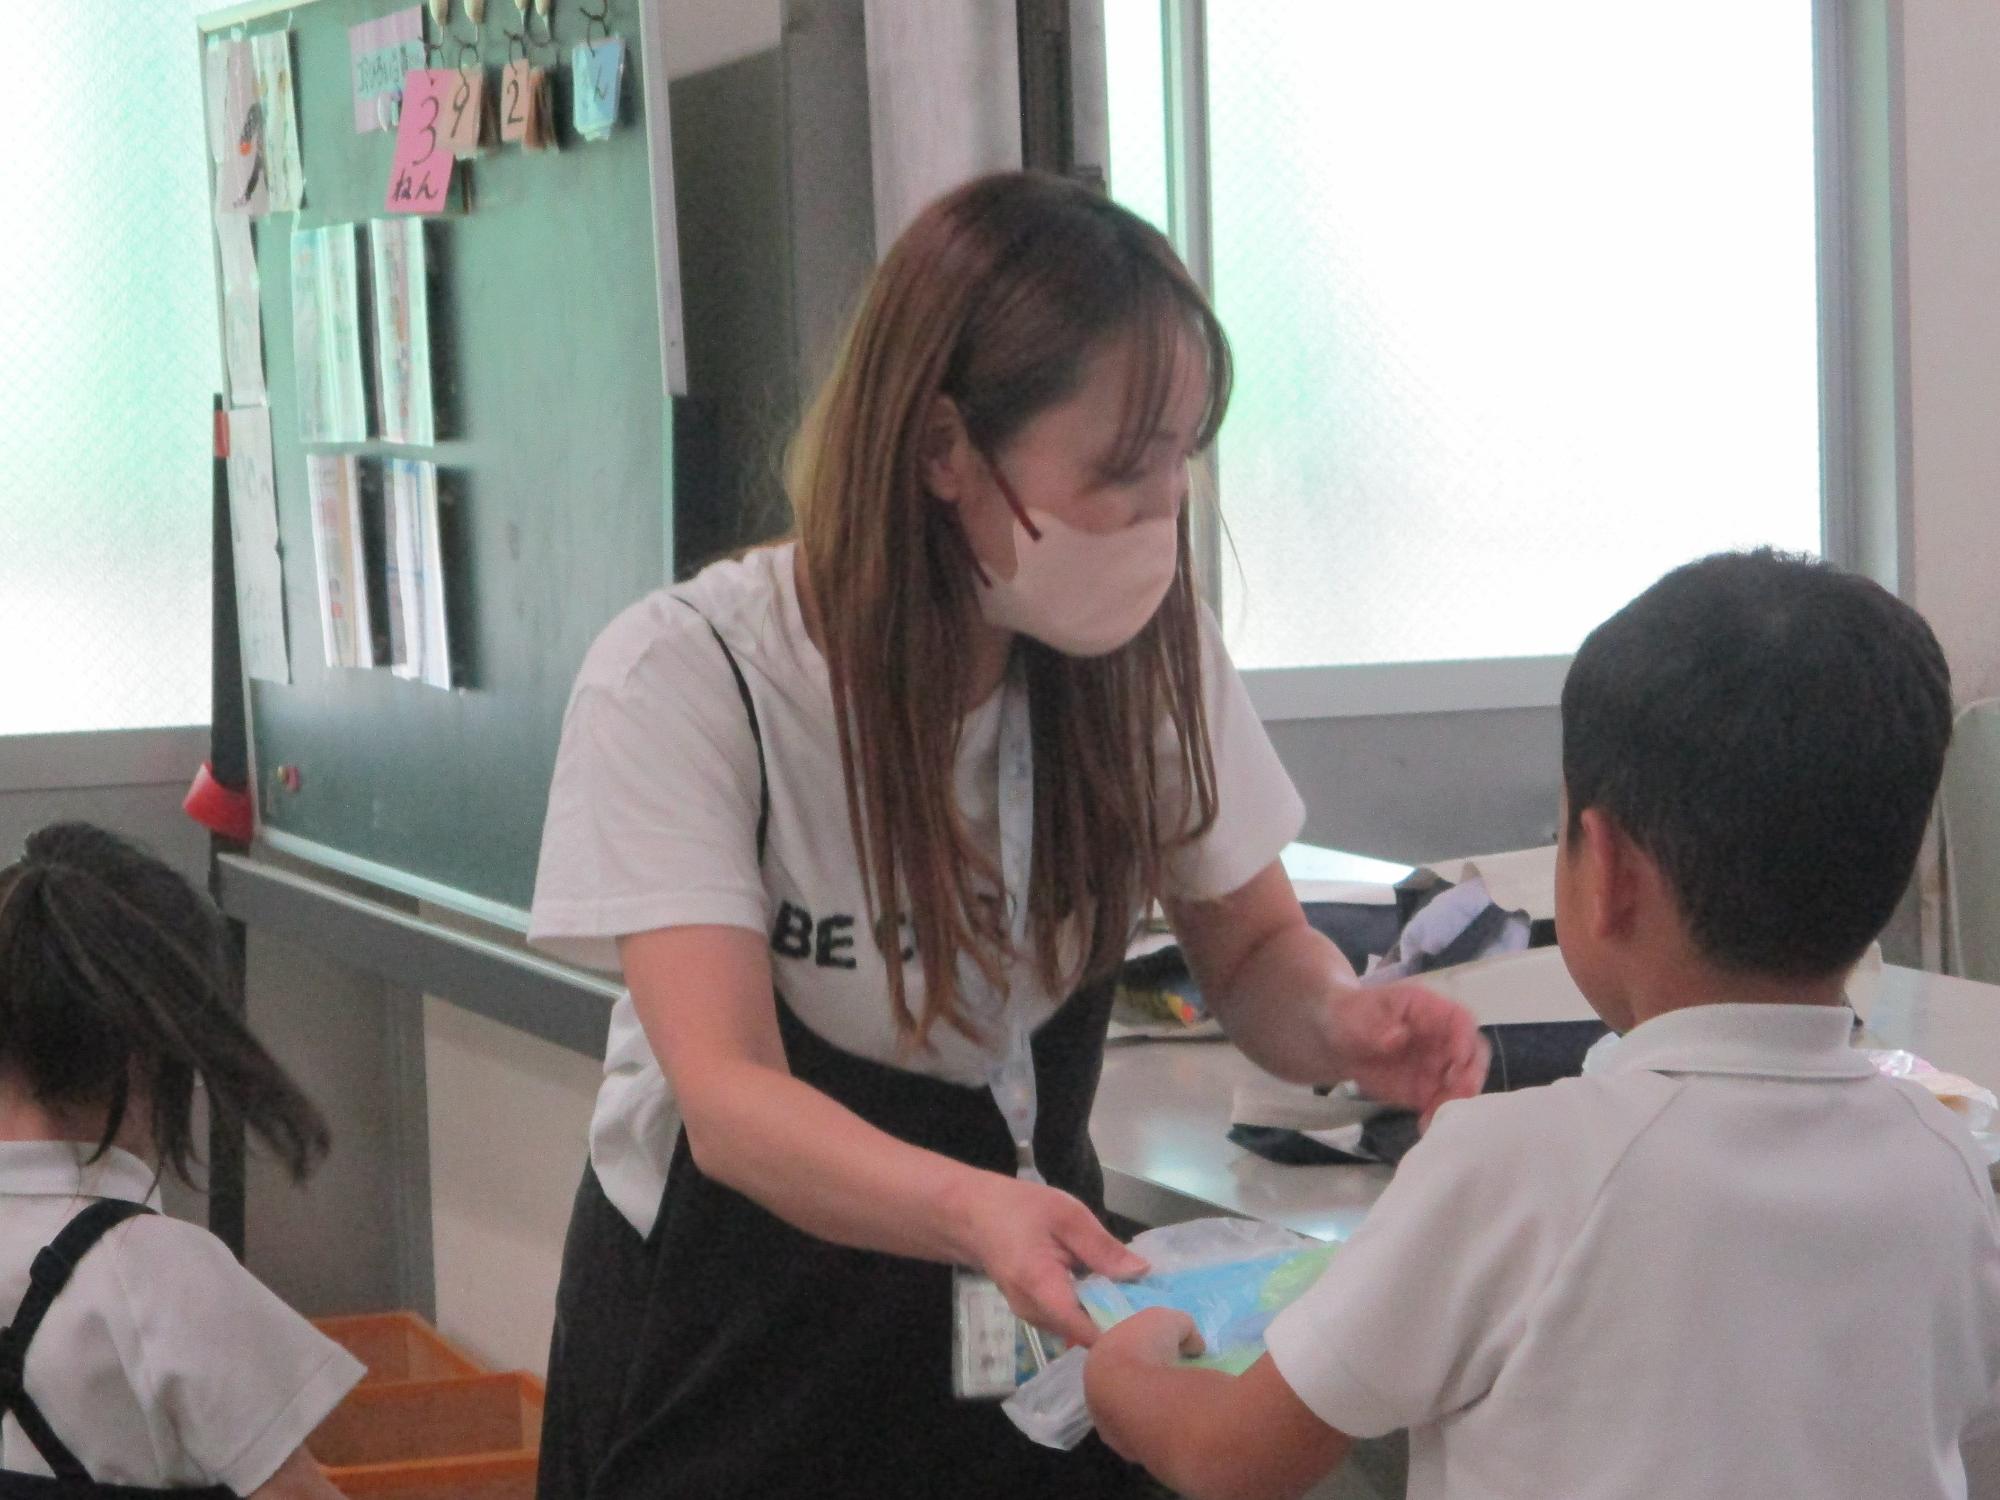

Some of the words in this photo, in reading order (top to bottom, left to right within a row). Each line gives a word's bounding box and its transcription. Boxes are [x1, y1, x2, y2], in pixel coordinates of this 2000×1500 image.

[450, 82, 470, 138] 9
[507, 79, 524, 124] 2
[412, 96, 439, 166] 3
[392, 168, 439, 201] ねん
[771, 901, 856, 969] BE
